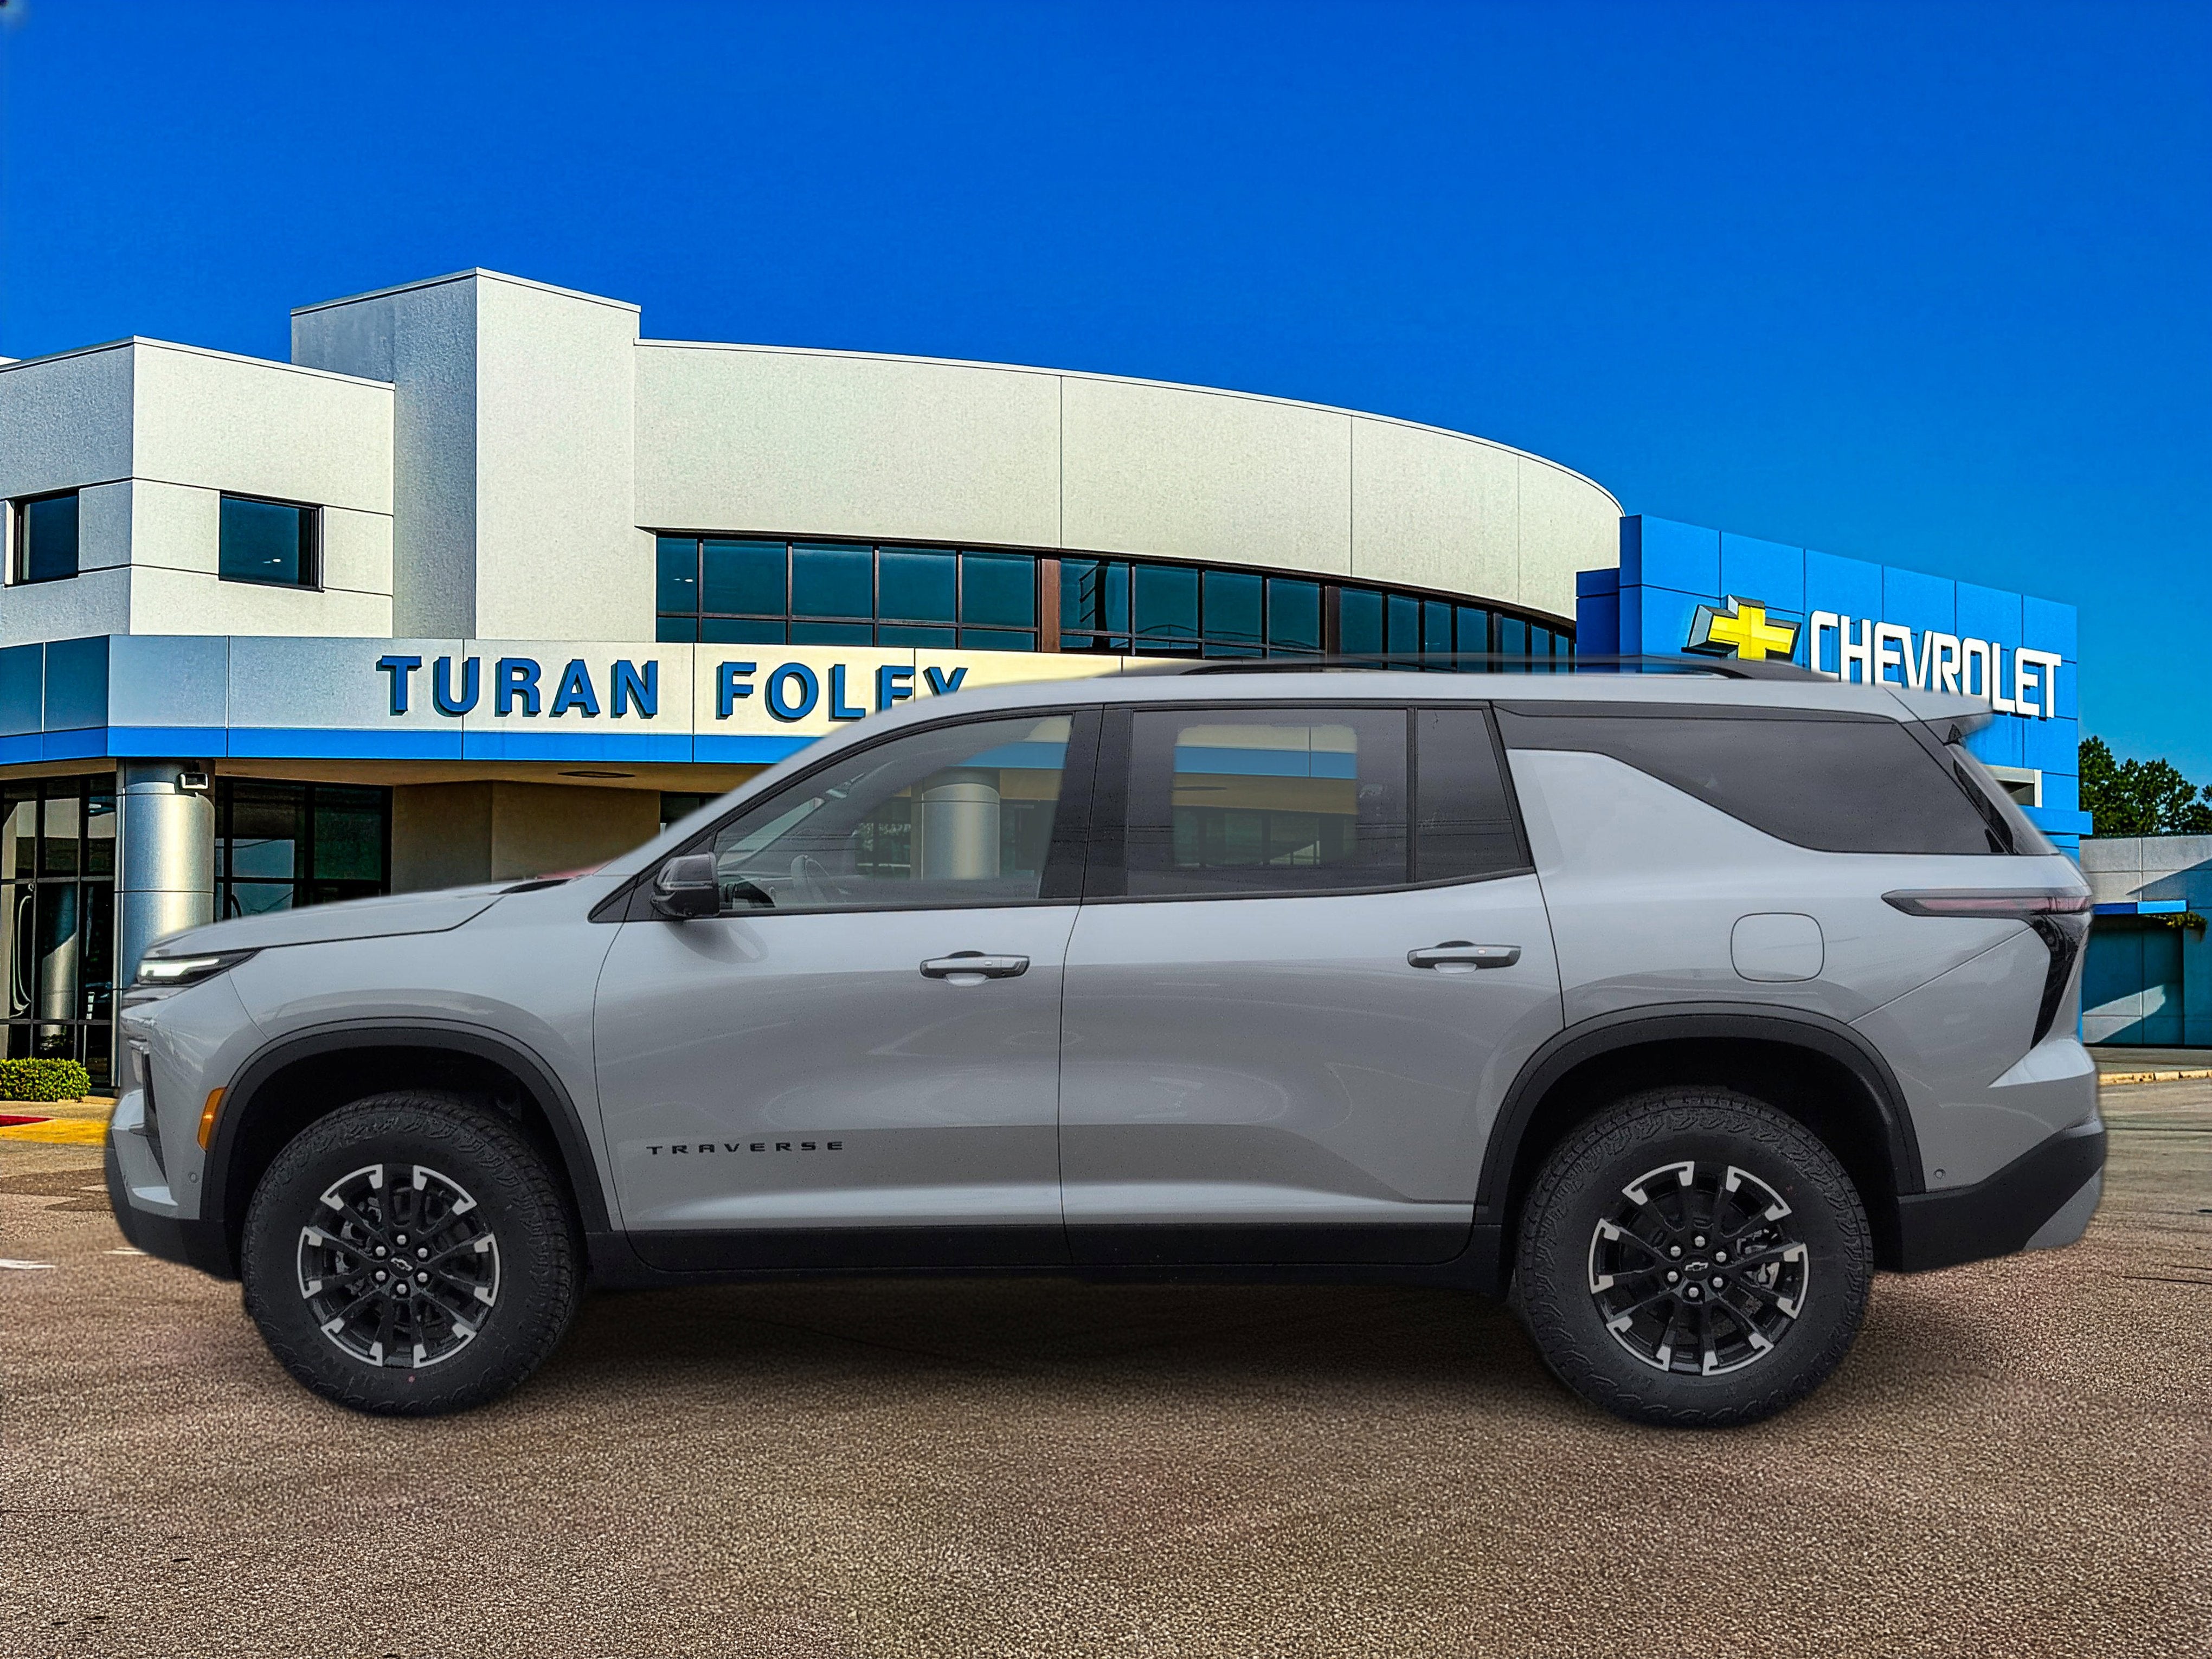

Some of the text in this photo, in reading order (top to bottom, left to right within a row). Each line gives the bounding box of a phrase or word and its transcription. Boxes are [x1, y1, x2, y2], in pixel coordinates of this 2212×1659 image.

[377, 655, 659, 719] TURAN
[1810, 610, 2062, 718] CHEVROLET
[646, 1141, 843, 1155] TRAVERSE
